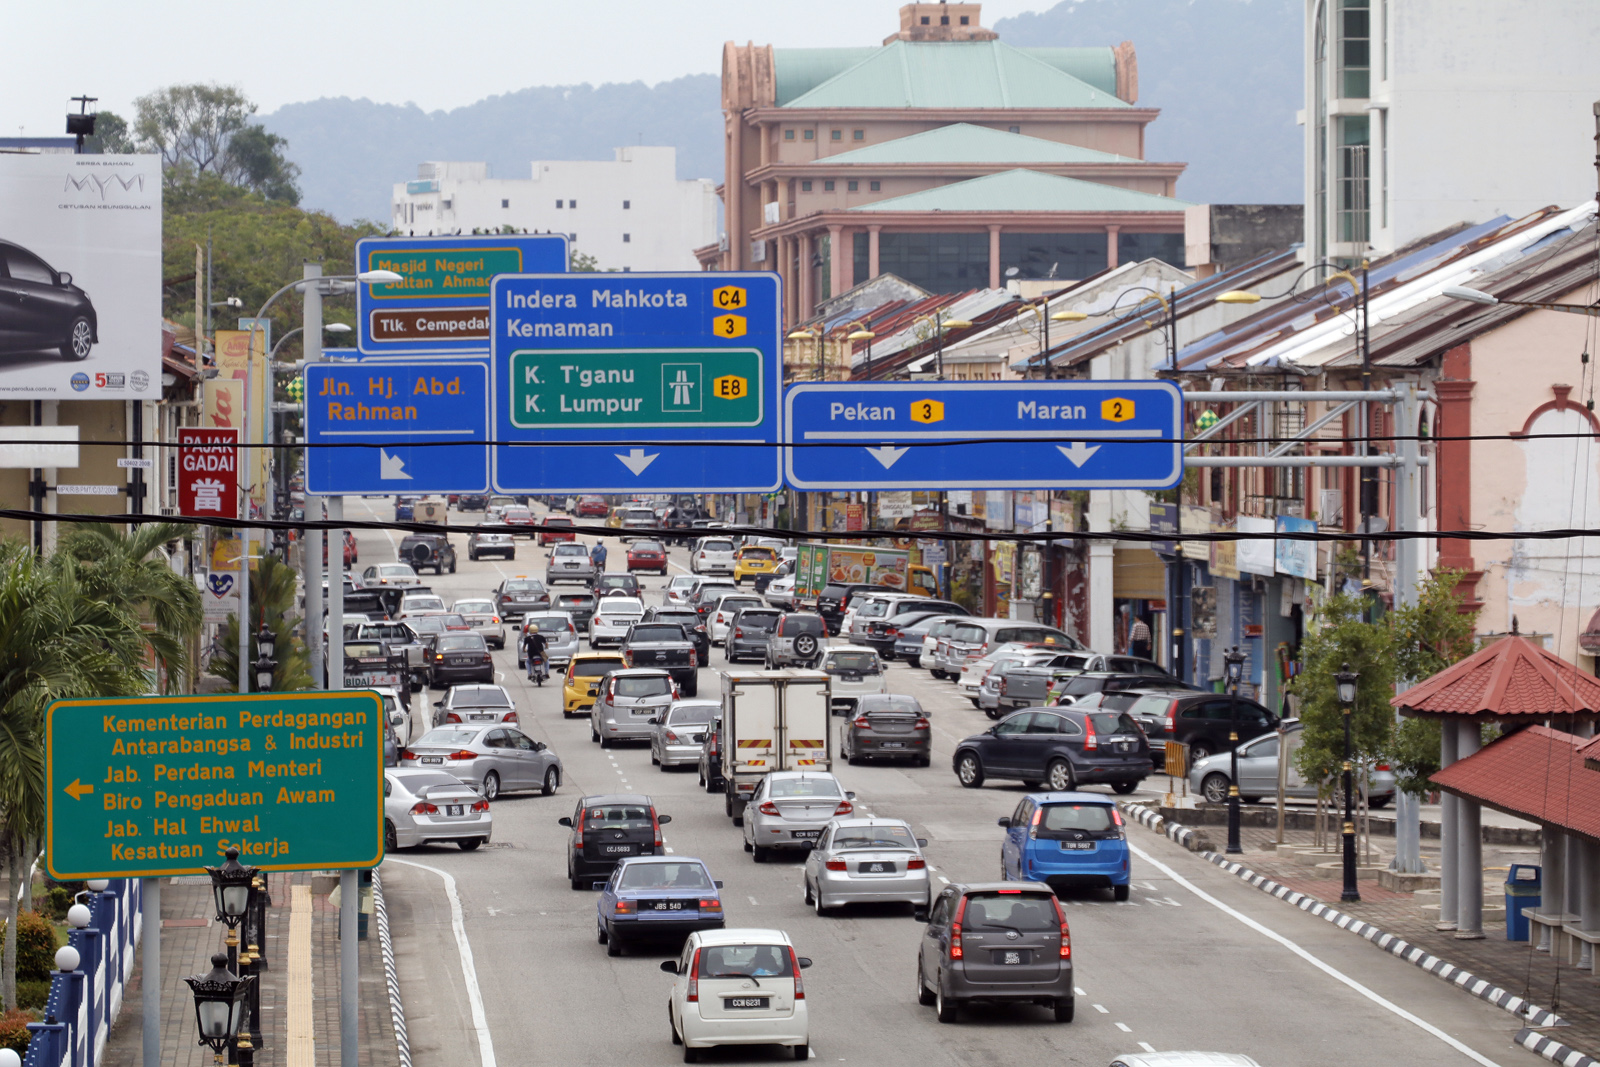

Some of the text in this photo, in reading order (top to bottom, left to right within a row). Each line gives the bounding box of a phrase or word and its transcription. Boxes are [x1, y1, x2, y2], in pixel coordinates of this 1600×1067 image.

[379, 258, 483, 276] Masjid Negeri
[507, 290, 741, 308] Indera Mahkota C4
[380, 319, 406, 331] Tlk.
[508, 319, 734, 337] Kemaman 3
[95, 372, 106, 388] 5
[319, 377, 465, 398] Jln. Hj. Abd.
[525, 366, 741, 397] K. T'ganu E8
[329, 402, 417, 420] Rahman
[526, 395, 642, 415] K. Lumpur
[831, 401, 1124, 420] Pekan 3 Maran 2
[183, 436, 234, 454] PAJAK
[183, 455, 235, 472] GADAI
[104, 710, 366, 732] Kementerian Perdagangan
[112, 731, 363, 755] Antarabangsa & Industri
[104, 759, 321, 783] Jab. Perdana Menteri
[104, 787, 335, 810] Biro Pengaduan Awam
[593, 810, 601, 818] P
[104, 815, 260, 837] Jab. Hal Ehwal
[112, 843, 202, 860] Kesatuan
